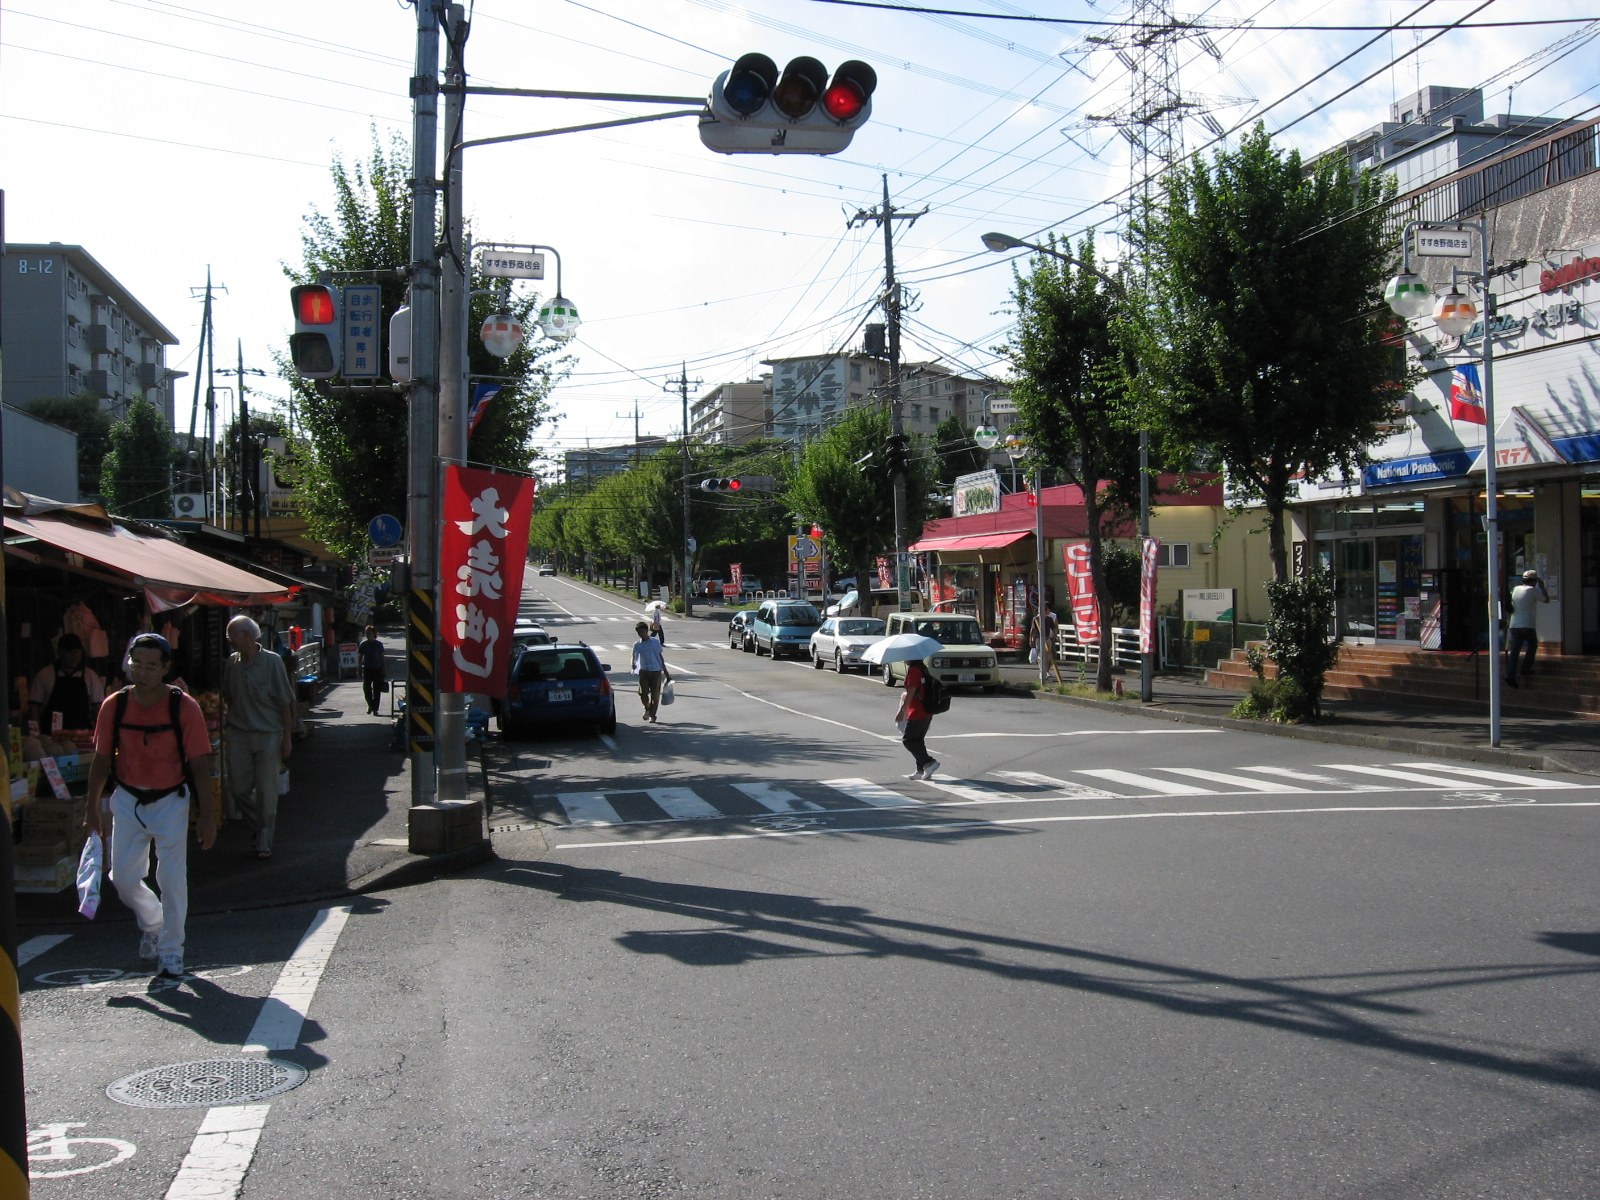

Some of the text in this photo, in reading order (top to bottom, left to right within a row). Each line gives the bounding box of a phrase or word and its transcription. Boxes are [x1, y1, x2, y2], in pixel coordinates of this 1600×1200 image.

[1420, 238, 1468, 249] すすき野商店会
[486, 259, 540, 270] すすき野商店会
